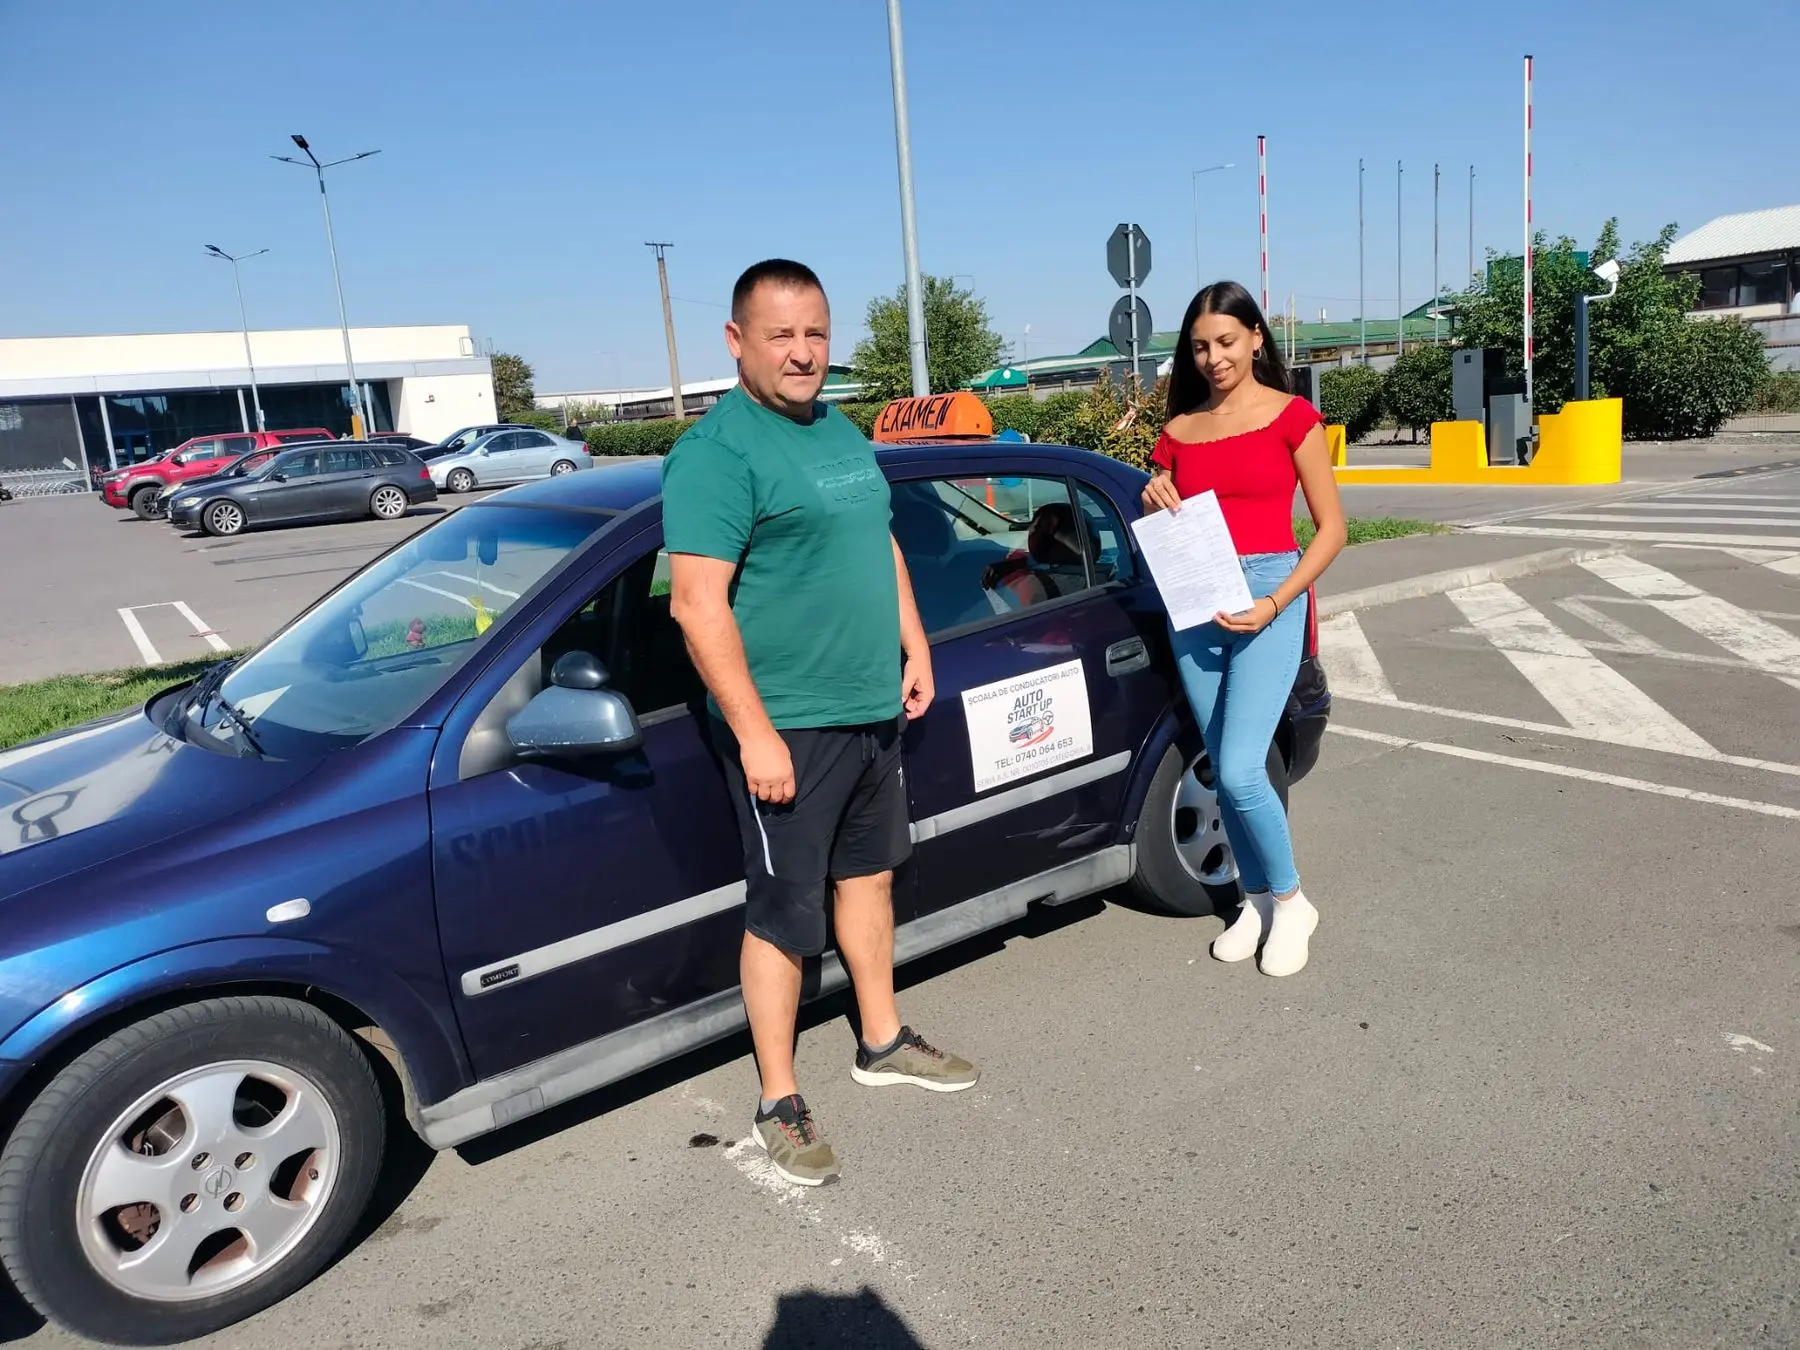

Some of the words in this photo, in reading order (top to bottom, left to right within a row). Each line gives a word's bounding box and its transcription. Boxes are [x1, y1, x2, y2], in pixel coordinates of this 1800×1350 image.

[880, 397, 955, 432] EXAMEN
[998, 687, 1008, 696] DE
[1061, 667, 1079, 679] AUTO
[1007, 702, 1038, 724] START
[1039, 698, 1052, 712] UP
[1013, 689, 1043, 710] AUTO
[995, 758, 1013, 770] TEL:
[1015, 749, 1036, 763] 0740
[1039, 743, 1055, 755] 064
[1057, 737, 1073, 749] 653
[481, 968, 517, 985] COMFORT
